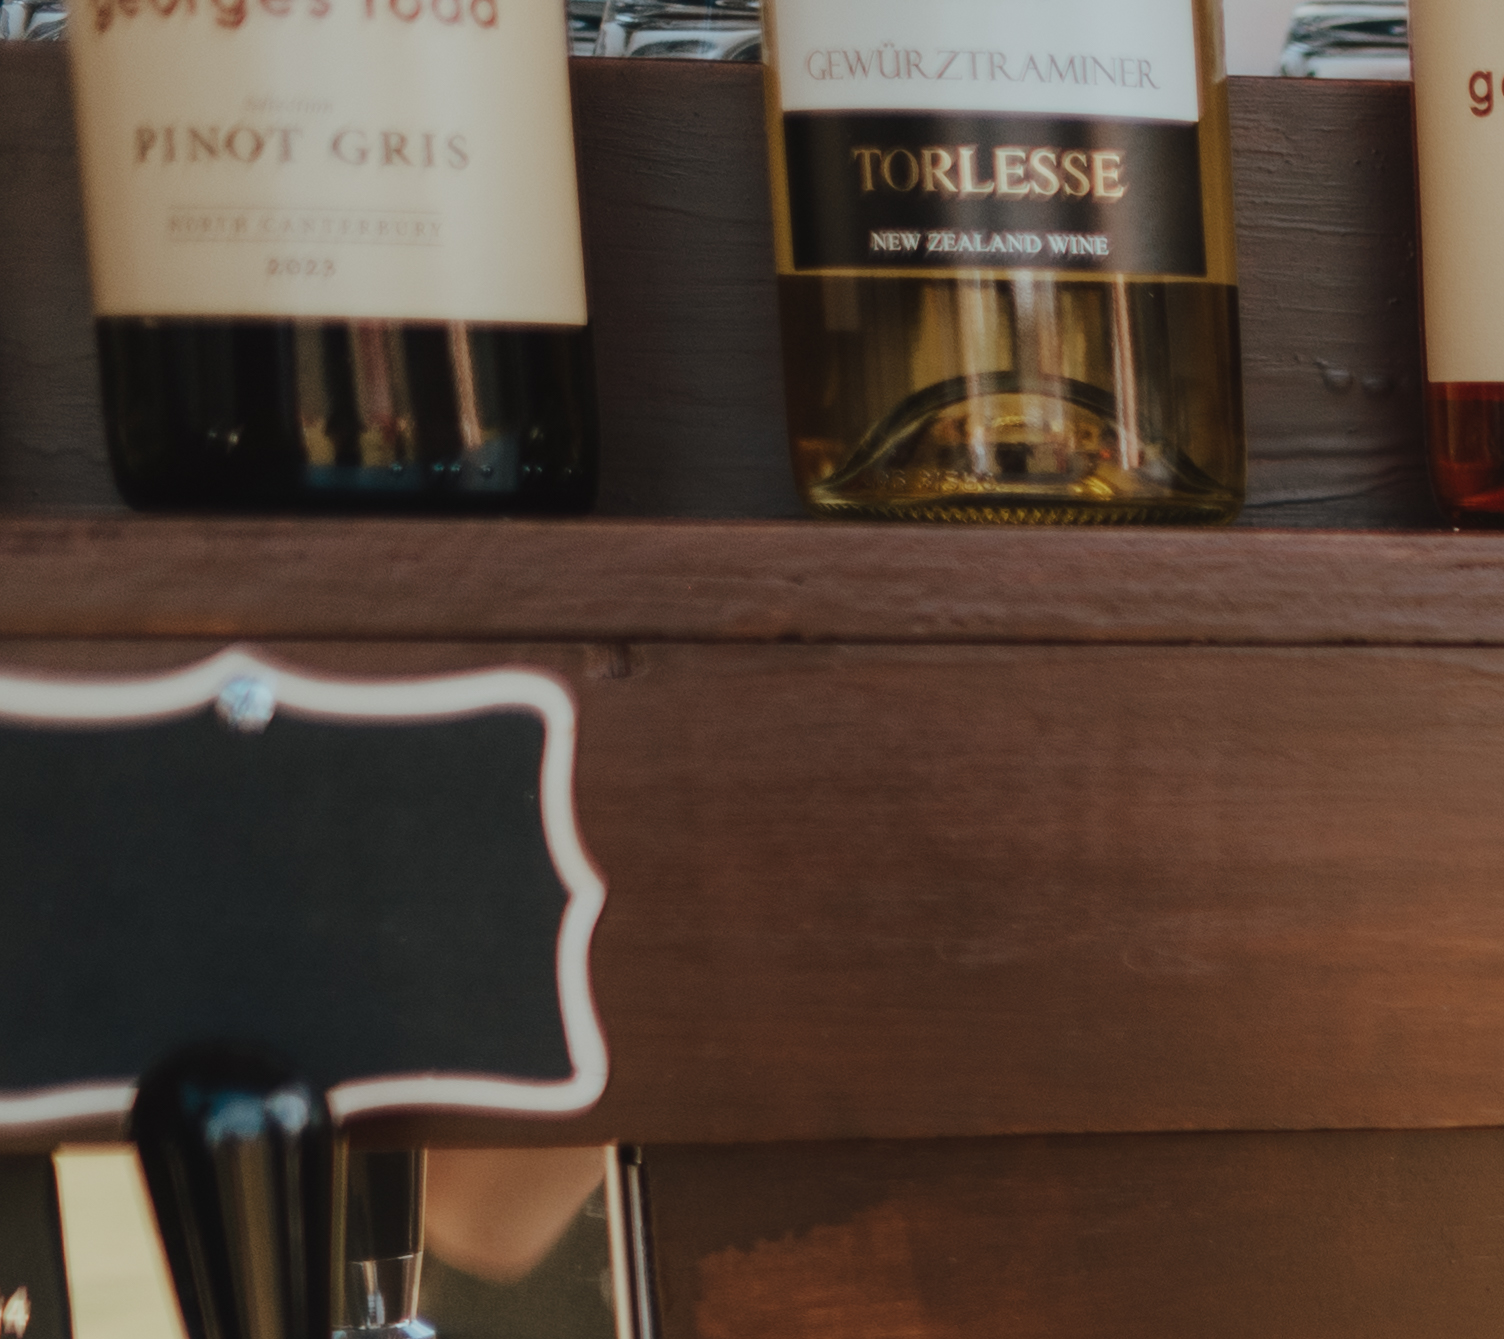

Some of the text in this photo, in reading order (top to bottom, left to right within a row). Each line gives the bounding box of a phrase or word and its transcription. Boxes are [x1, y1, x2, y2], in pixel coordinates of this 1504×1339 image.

[805, 40, 1160, 90] GEWÜRZTRAMINER
[135, 125, 471, 170] PINOT GRIS
[852, 144, 1130, 199] TORLESSE
[870, 230, 1110, 256] NEW ZEALAND WINE
